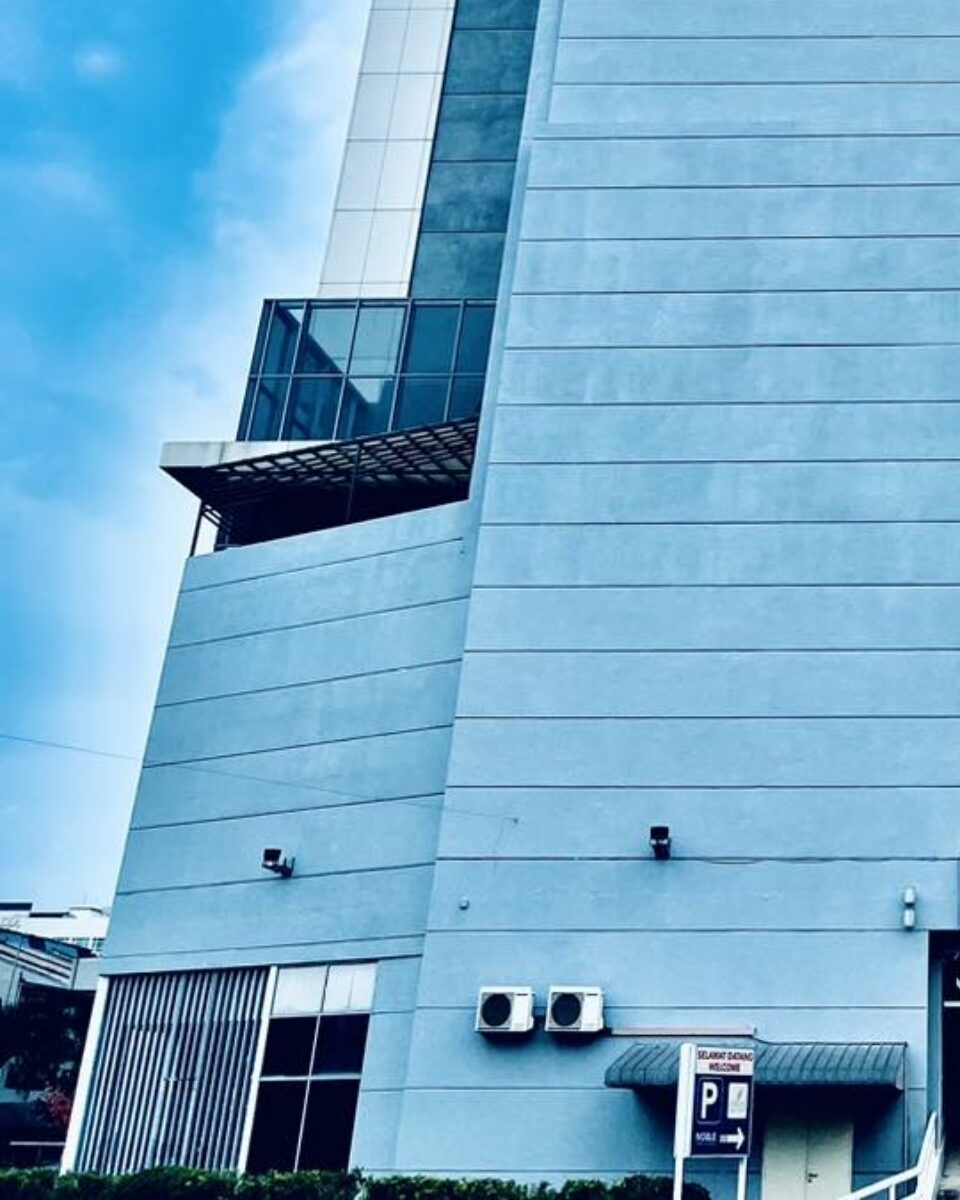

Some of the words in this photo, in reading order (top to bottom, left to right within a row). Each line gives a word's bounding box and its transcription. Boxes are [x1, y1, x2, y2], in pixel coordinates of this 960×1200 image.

[698, 1050, 727, 1060] SELAMAT
[727, 1051, 753, 1062] DATANG
[709, 1062, 741, 1072] WELCOME
[701, 1082, 718, 1119] P
